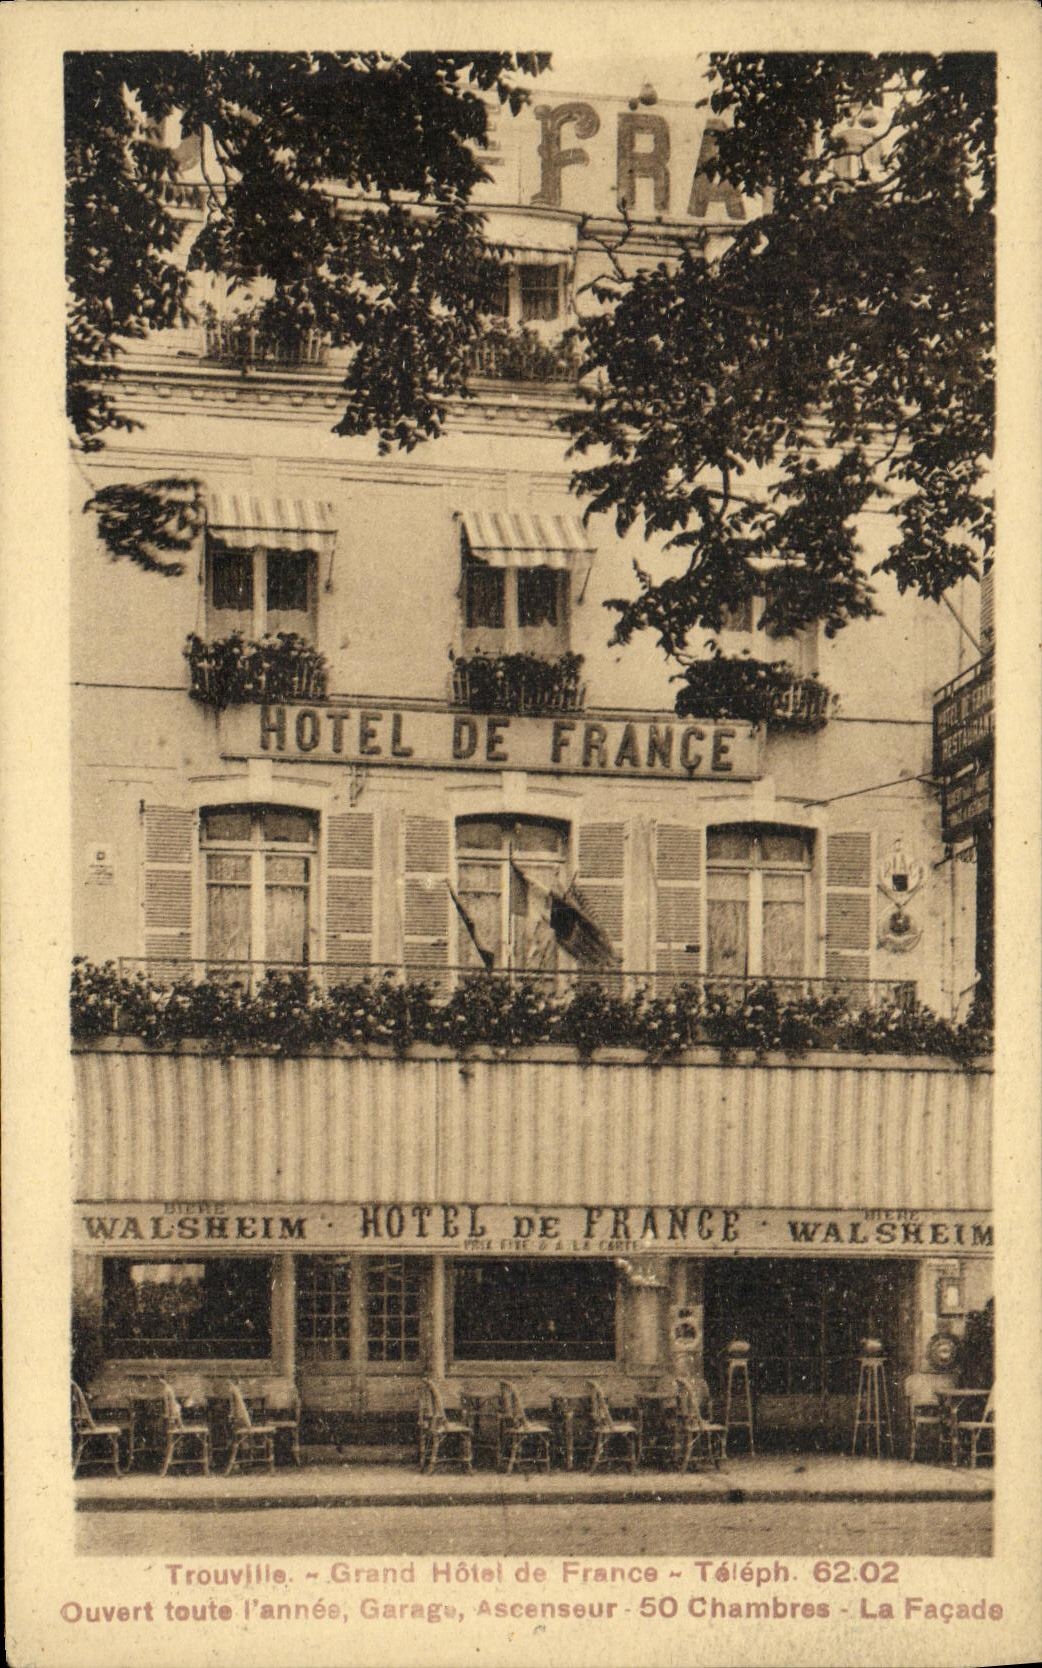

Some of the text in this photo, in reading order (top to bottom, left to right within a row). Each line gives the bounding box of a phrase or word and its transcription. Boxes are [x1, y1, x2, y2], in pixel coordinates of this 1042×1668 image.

[259, 705, 414, 759] HOTEL
[452, 714, 511, 762] DE
[82, 1215, 308, 1240] WALSHEIM
[361, 1204, 740, 1242] HOTEL DE FRANCE
[788, 1219, 994, 1247] WALSHEIM
